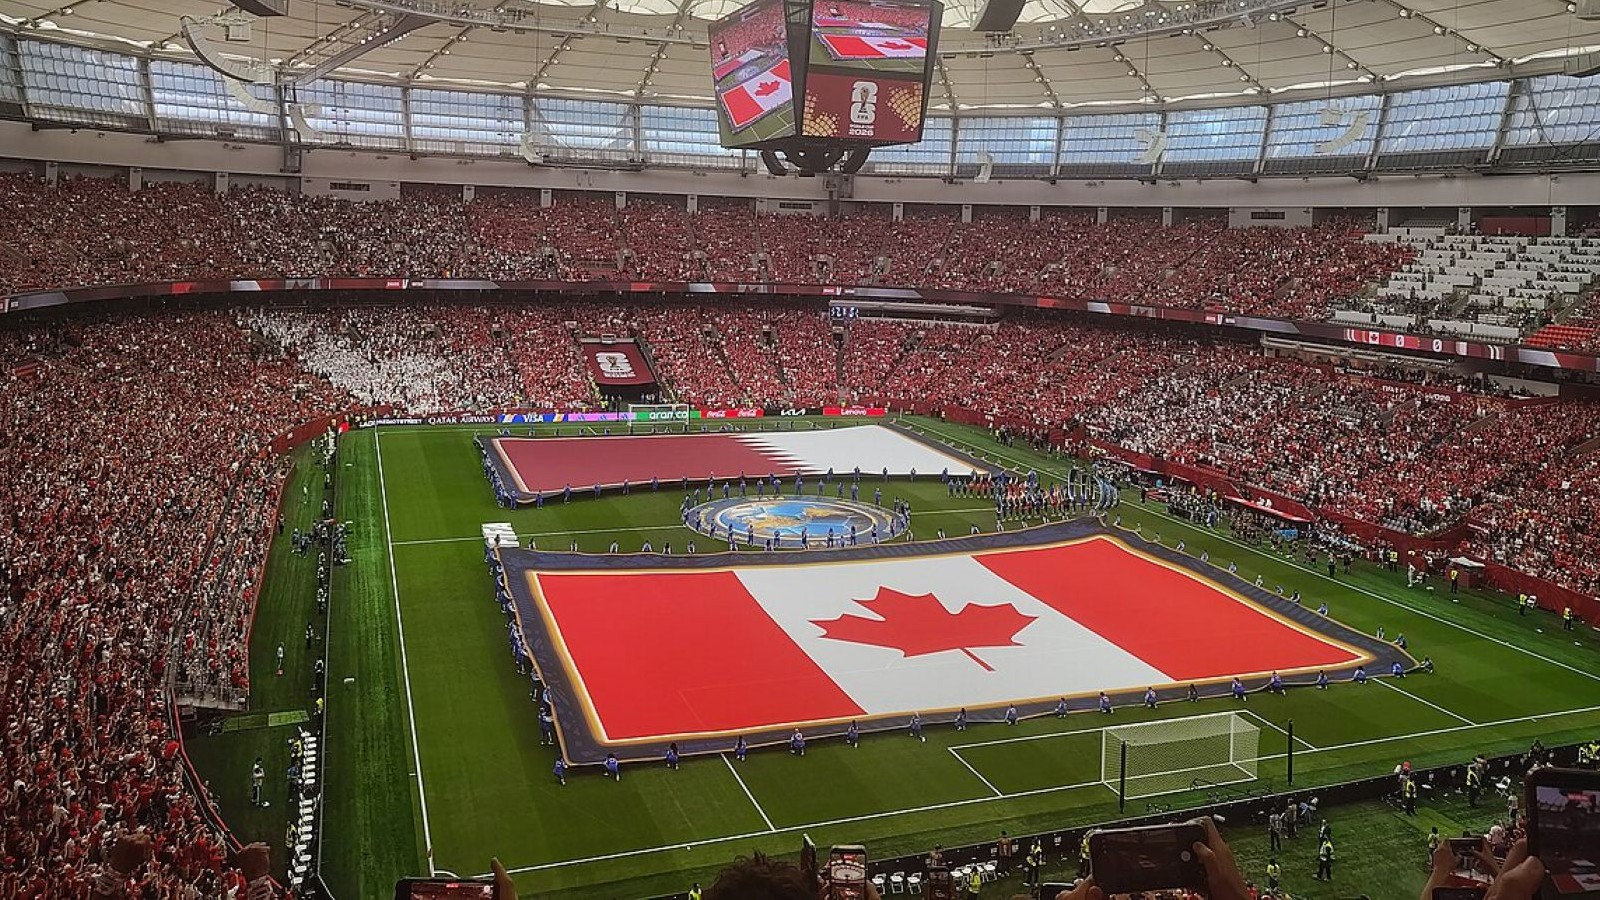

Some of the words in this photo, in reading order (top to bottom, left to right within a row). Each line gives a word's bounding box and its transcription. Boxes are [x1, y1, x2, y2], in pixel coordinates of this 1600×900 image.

[848, 128, 874, 136] 2026
[1433, 339, 1442, 352] 0
[649, 410, 688, 419] aramco
[780, 408, 806, 416] KIA
[841, 408, 867, 416] Lenovo
[428, 416, 457, 425] QATAR
[460, 415, 496, 423] AIRWAYS
[523, 414, 544, 423] VISA
